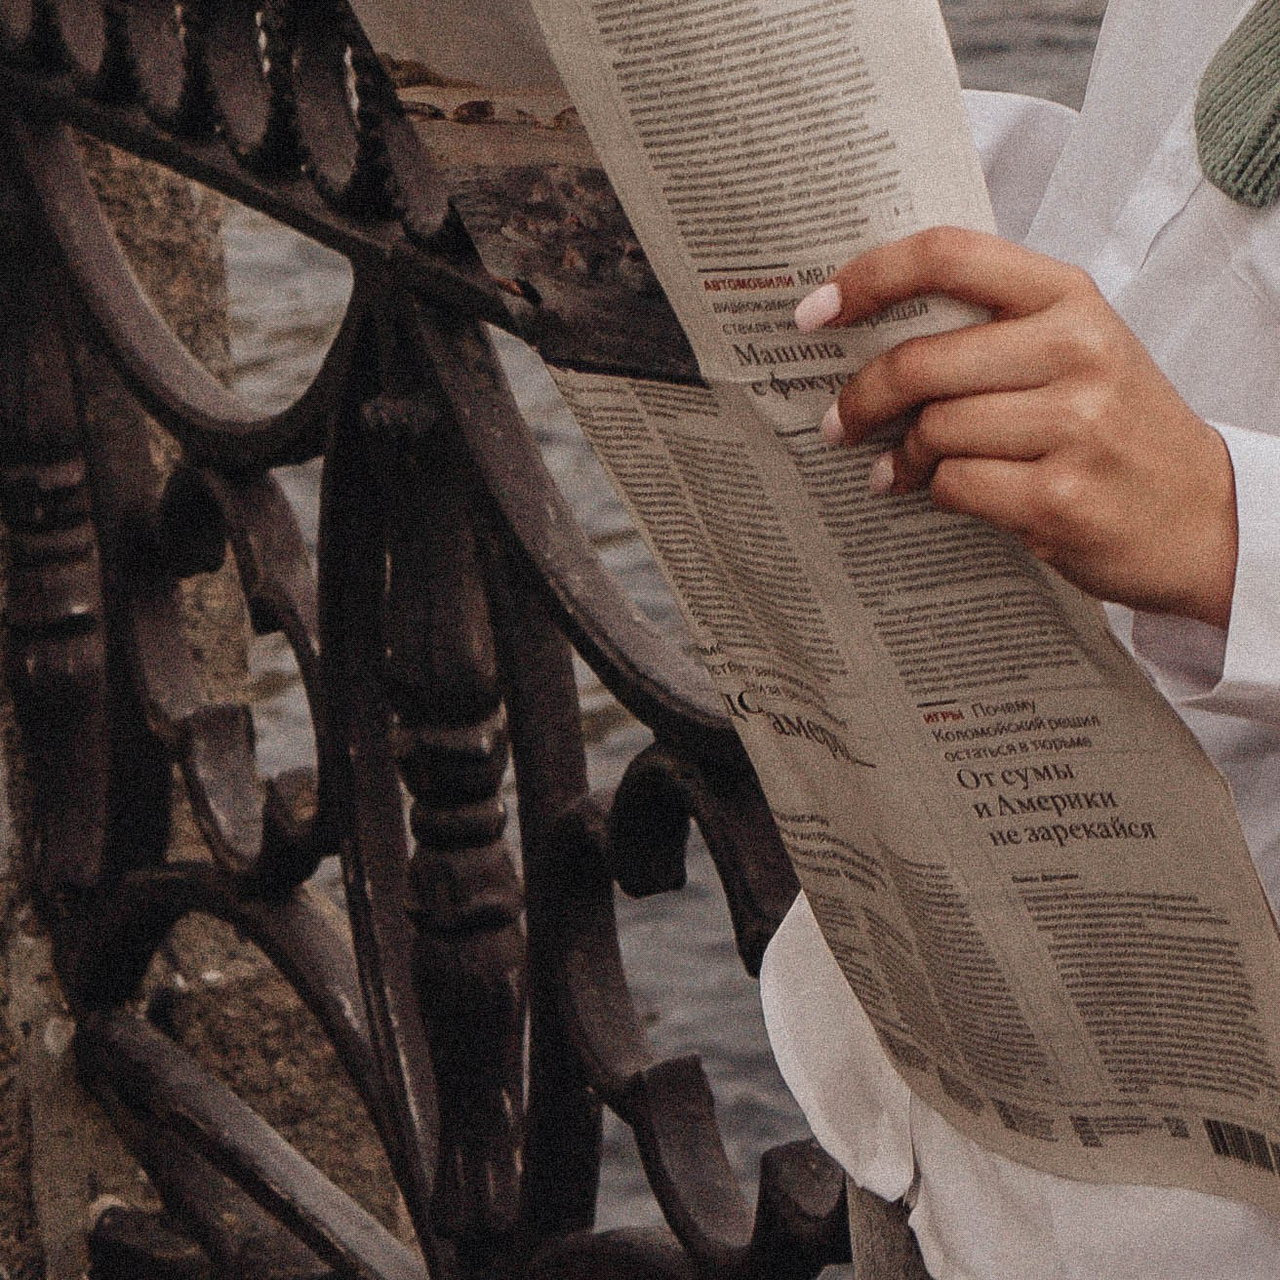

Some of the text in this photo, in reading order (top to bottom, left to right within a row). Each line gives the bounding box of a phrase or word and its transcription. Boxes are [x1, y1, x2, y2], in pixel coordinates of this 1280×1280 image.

[704, 275, 795, 291] АВТОМОБИЛИ
[732, 340, 846, 368] Машина
[752, 381, 768, 397] с
[923, 700, 1036, 725] ИГРЫ Почему
[931, 714, 1101, 743] Коломойский решил
[944, 735, 1093, 763] остаться в тюрьме
[956, 763, 1076, 790] От сумы
[974, 790, 1120, 819] и Америки
[989, 816, 1157, 848] не зарекайся
